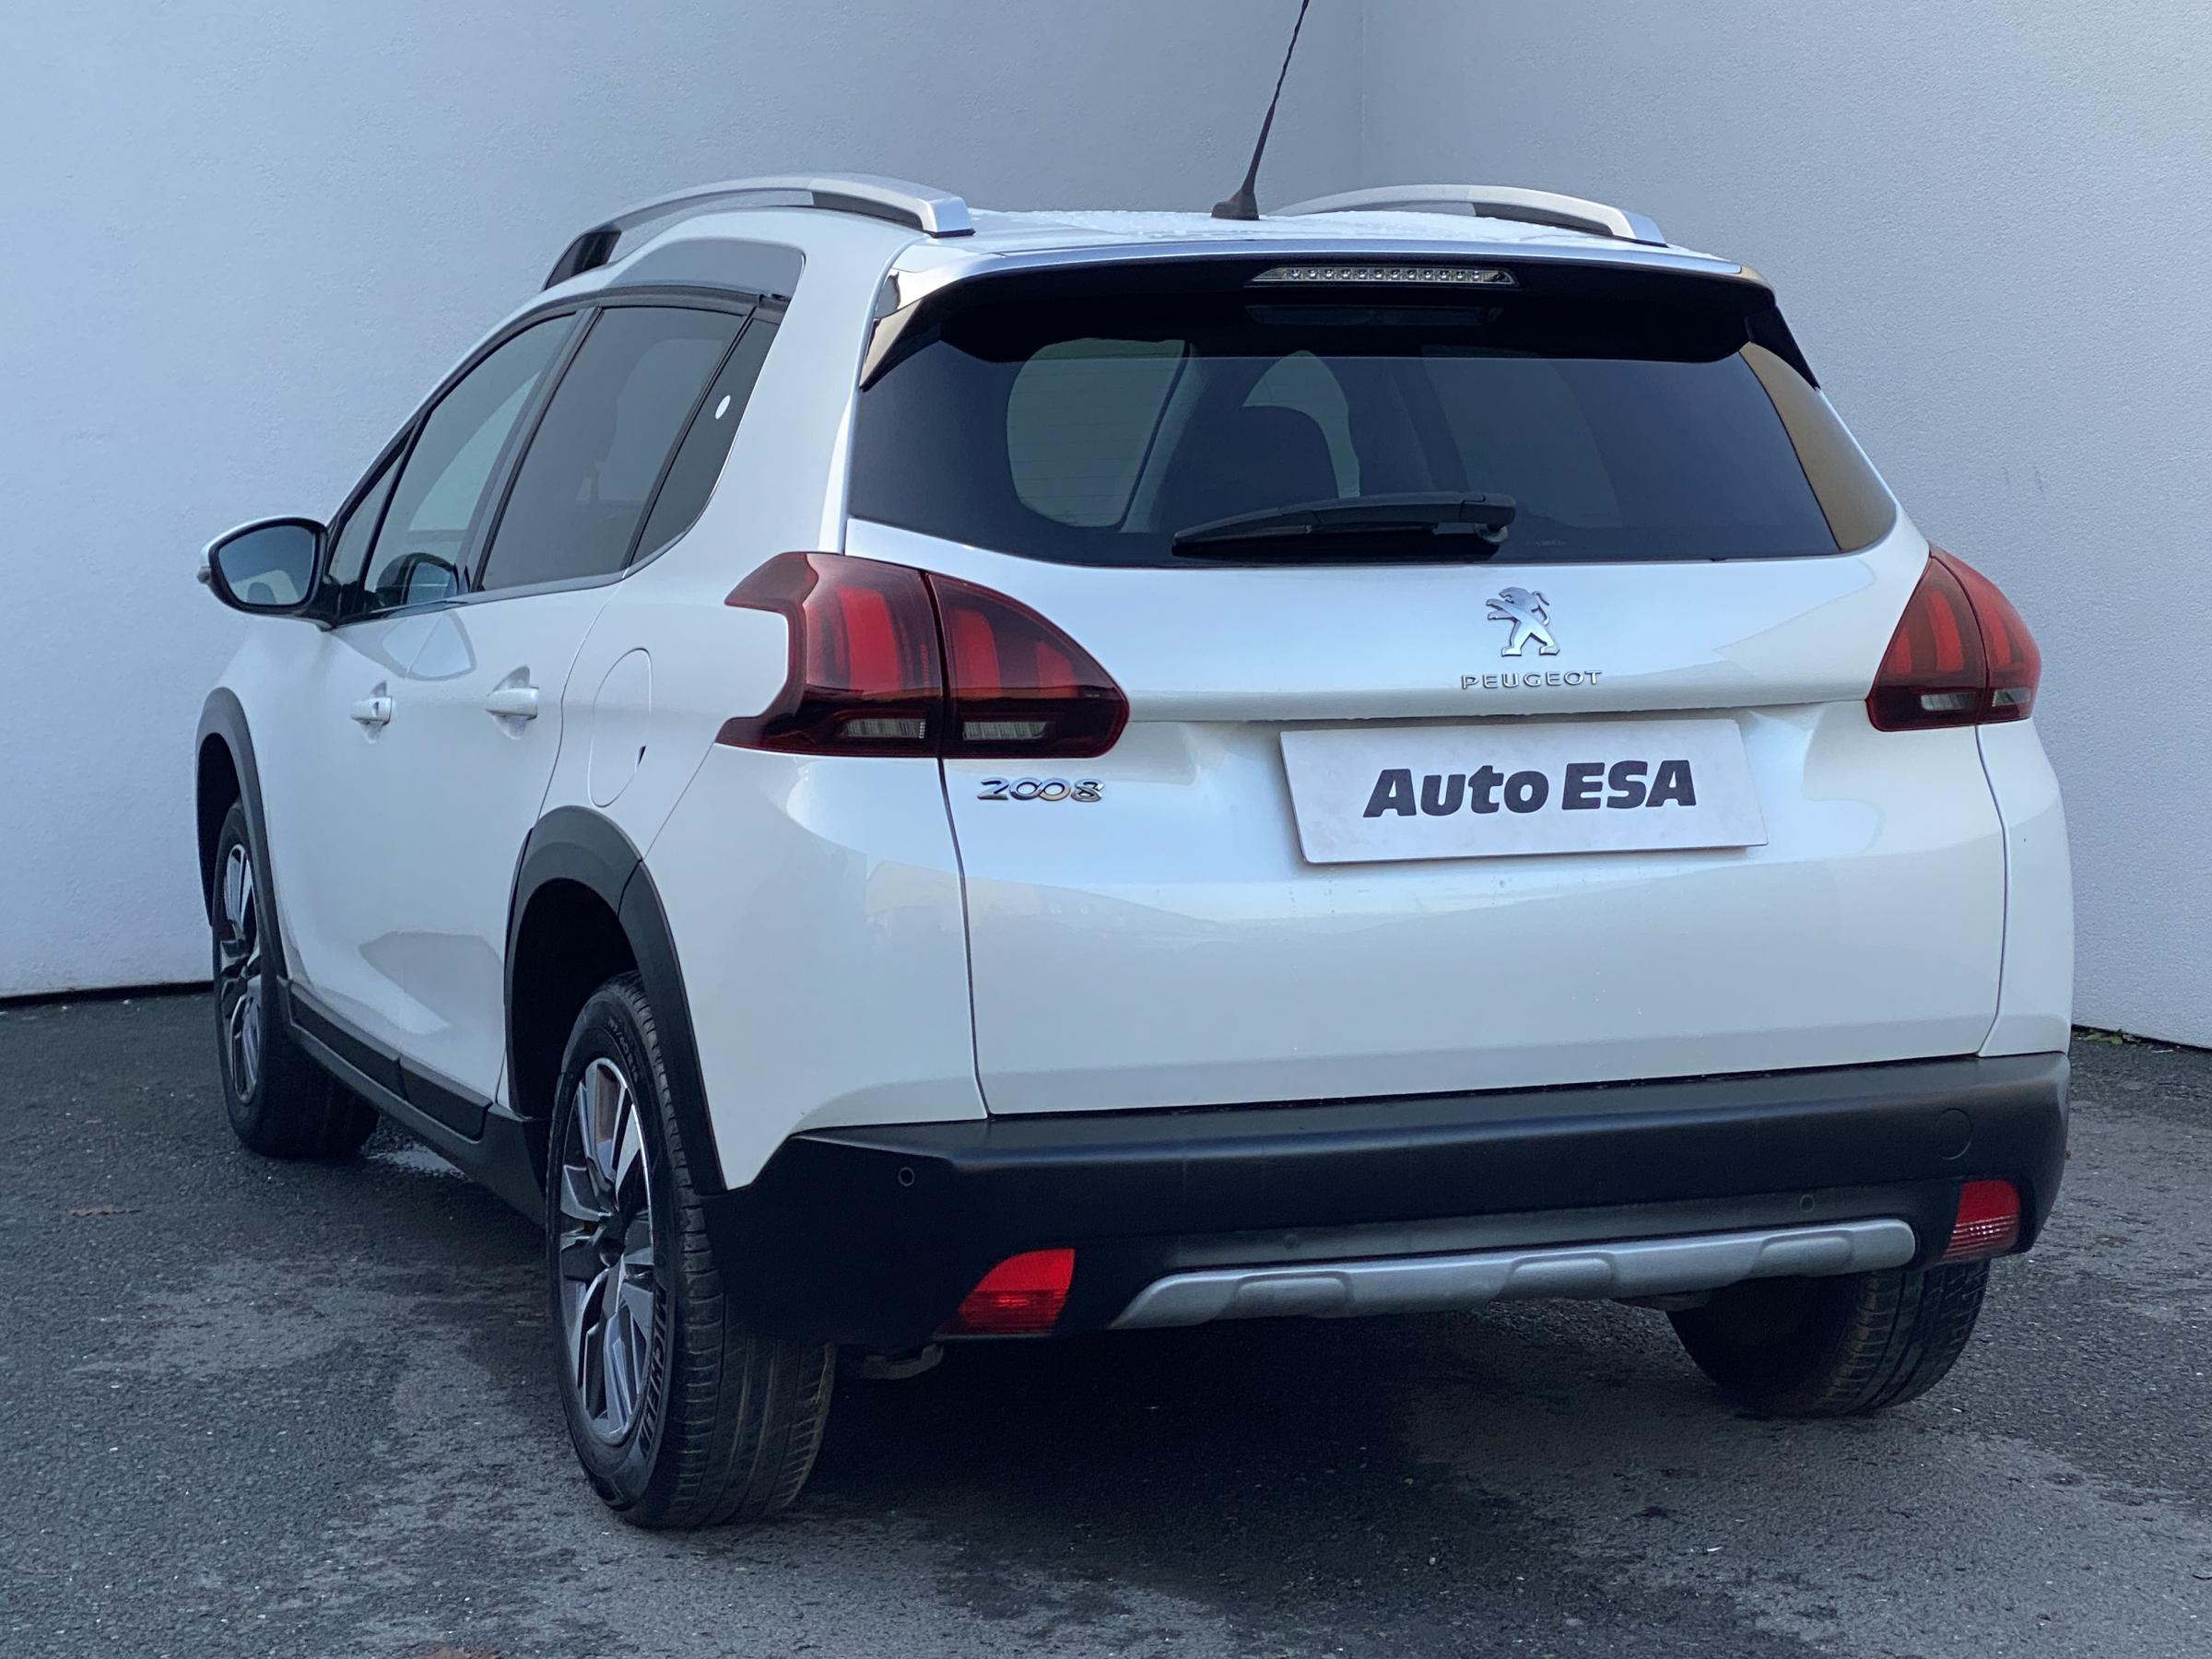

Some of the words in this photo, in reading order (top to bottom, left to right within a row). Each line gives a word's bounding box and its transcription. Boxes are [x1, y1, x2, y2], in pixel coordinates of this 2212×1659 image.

[1462, 670, 1603, 689] PEUGEOT
[977, 777, 1105, 803] 2008
[1363, 765, 1549, 817] Auto
[1562, 759, 1697, 810] ESA
